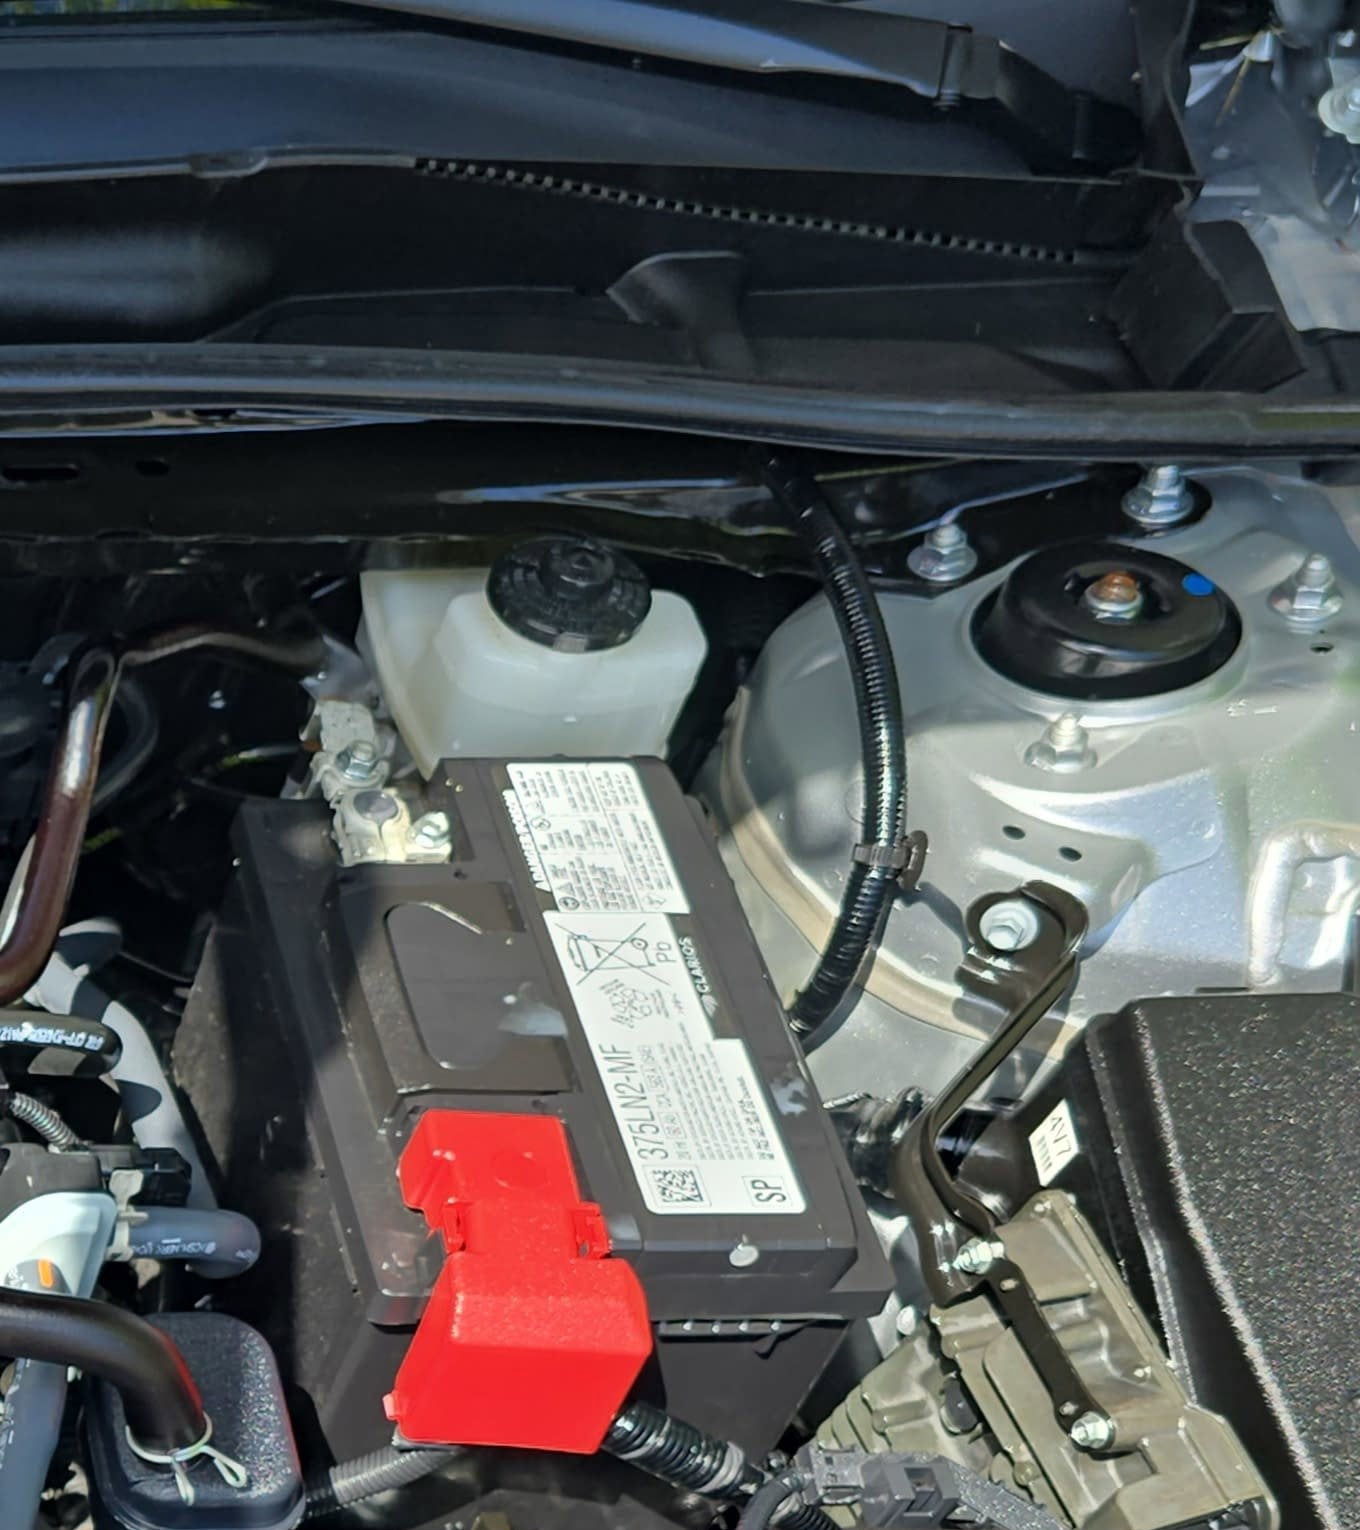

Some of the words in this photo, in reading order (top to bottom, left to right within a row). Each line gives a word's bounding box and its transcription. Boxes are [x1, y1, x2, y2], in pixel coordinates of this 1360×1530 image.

[655, 941, 677, 963] Pb
[676, 935, 710, 992] CLARIOS
[599, 1044, 669, 1160] 375LN2-MF
[751, 1179, 787, 1204] SP
